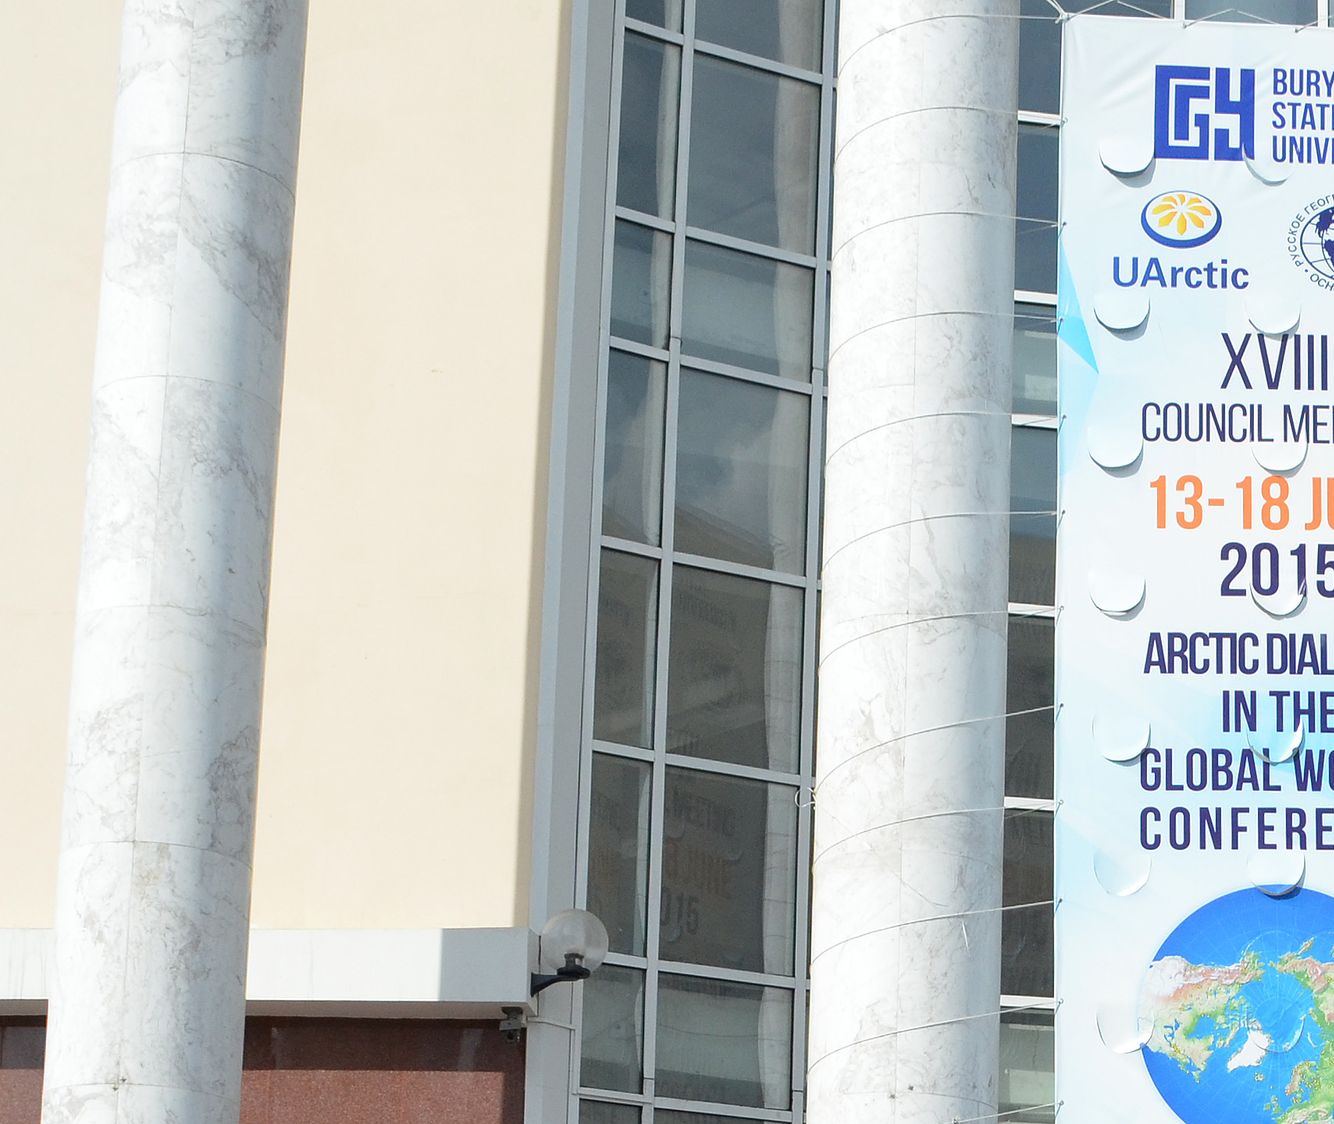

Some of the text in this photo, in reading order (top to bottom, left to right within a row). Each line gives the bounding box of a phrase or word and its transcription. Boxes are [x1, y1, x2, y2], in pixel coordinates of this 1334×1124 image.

[1287, 213, 1306, 267] РУССКОЕ
[1113, 256, 1249, 290] UArctic
[1220, 332, 1328, 391] XVIII
[1141, 402, 1275, 443] COUNCIL
[1143, 631, 1260, 675] ARCTIC
[1222, 689, 1257, 733] IN
[1139, 747, 1282, 792] GLOBAL
